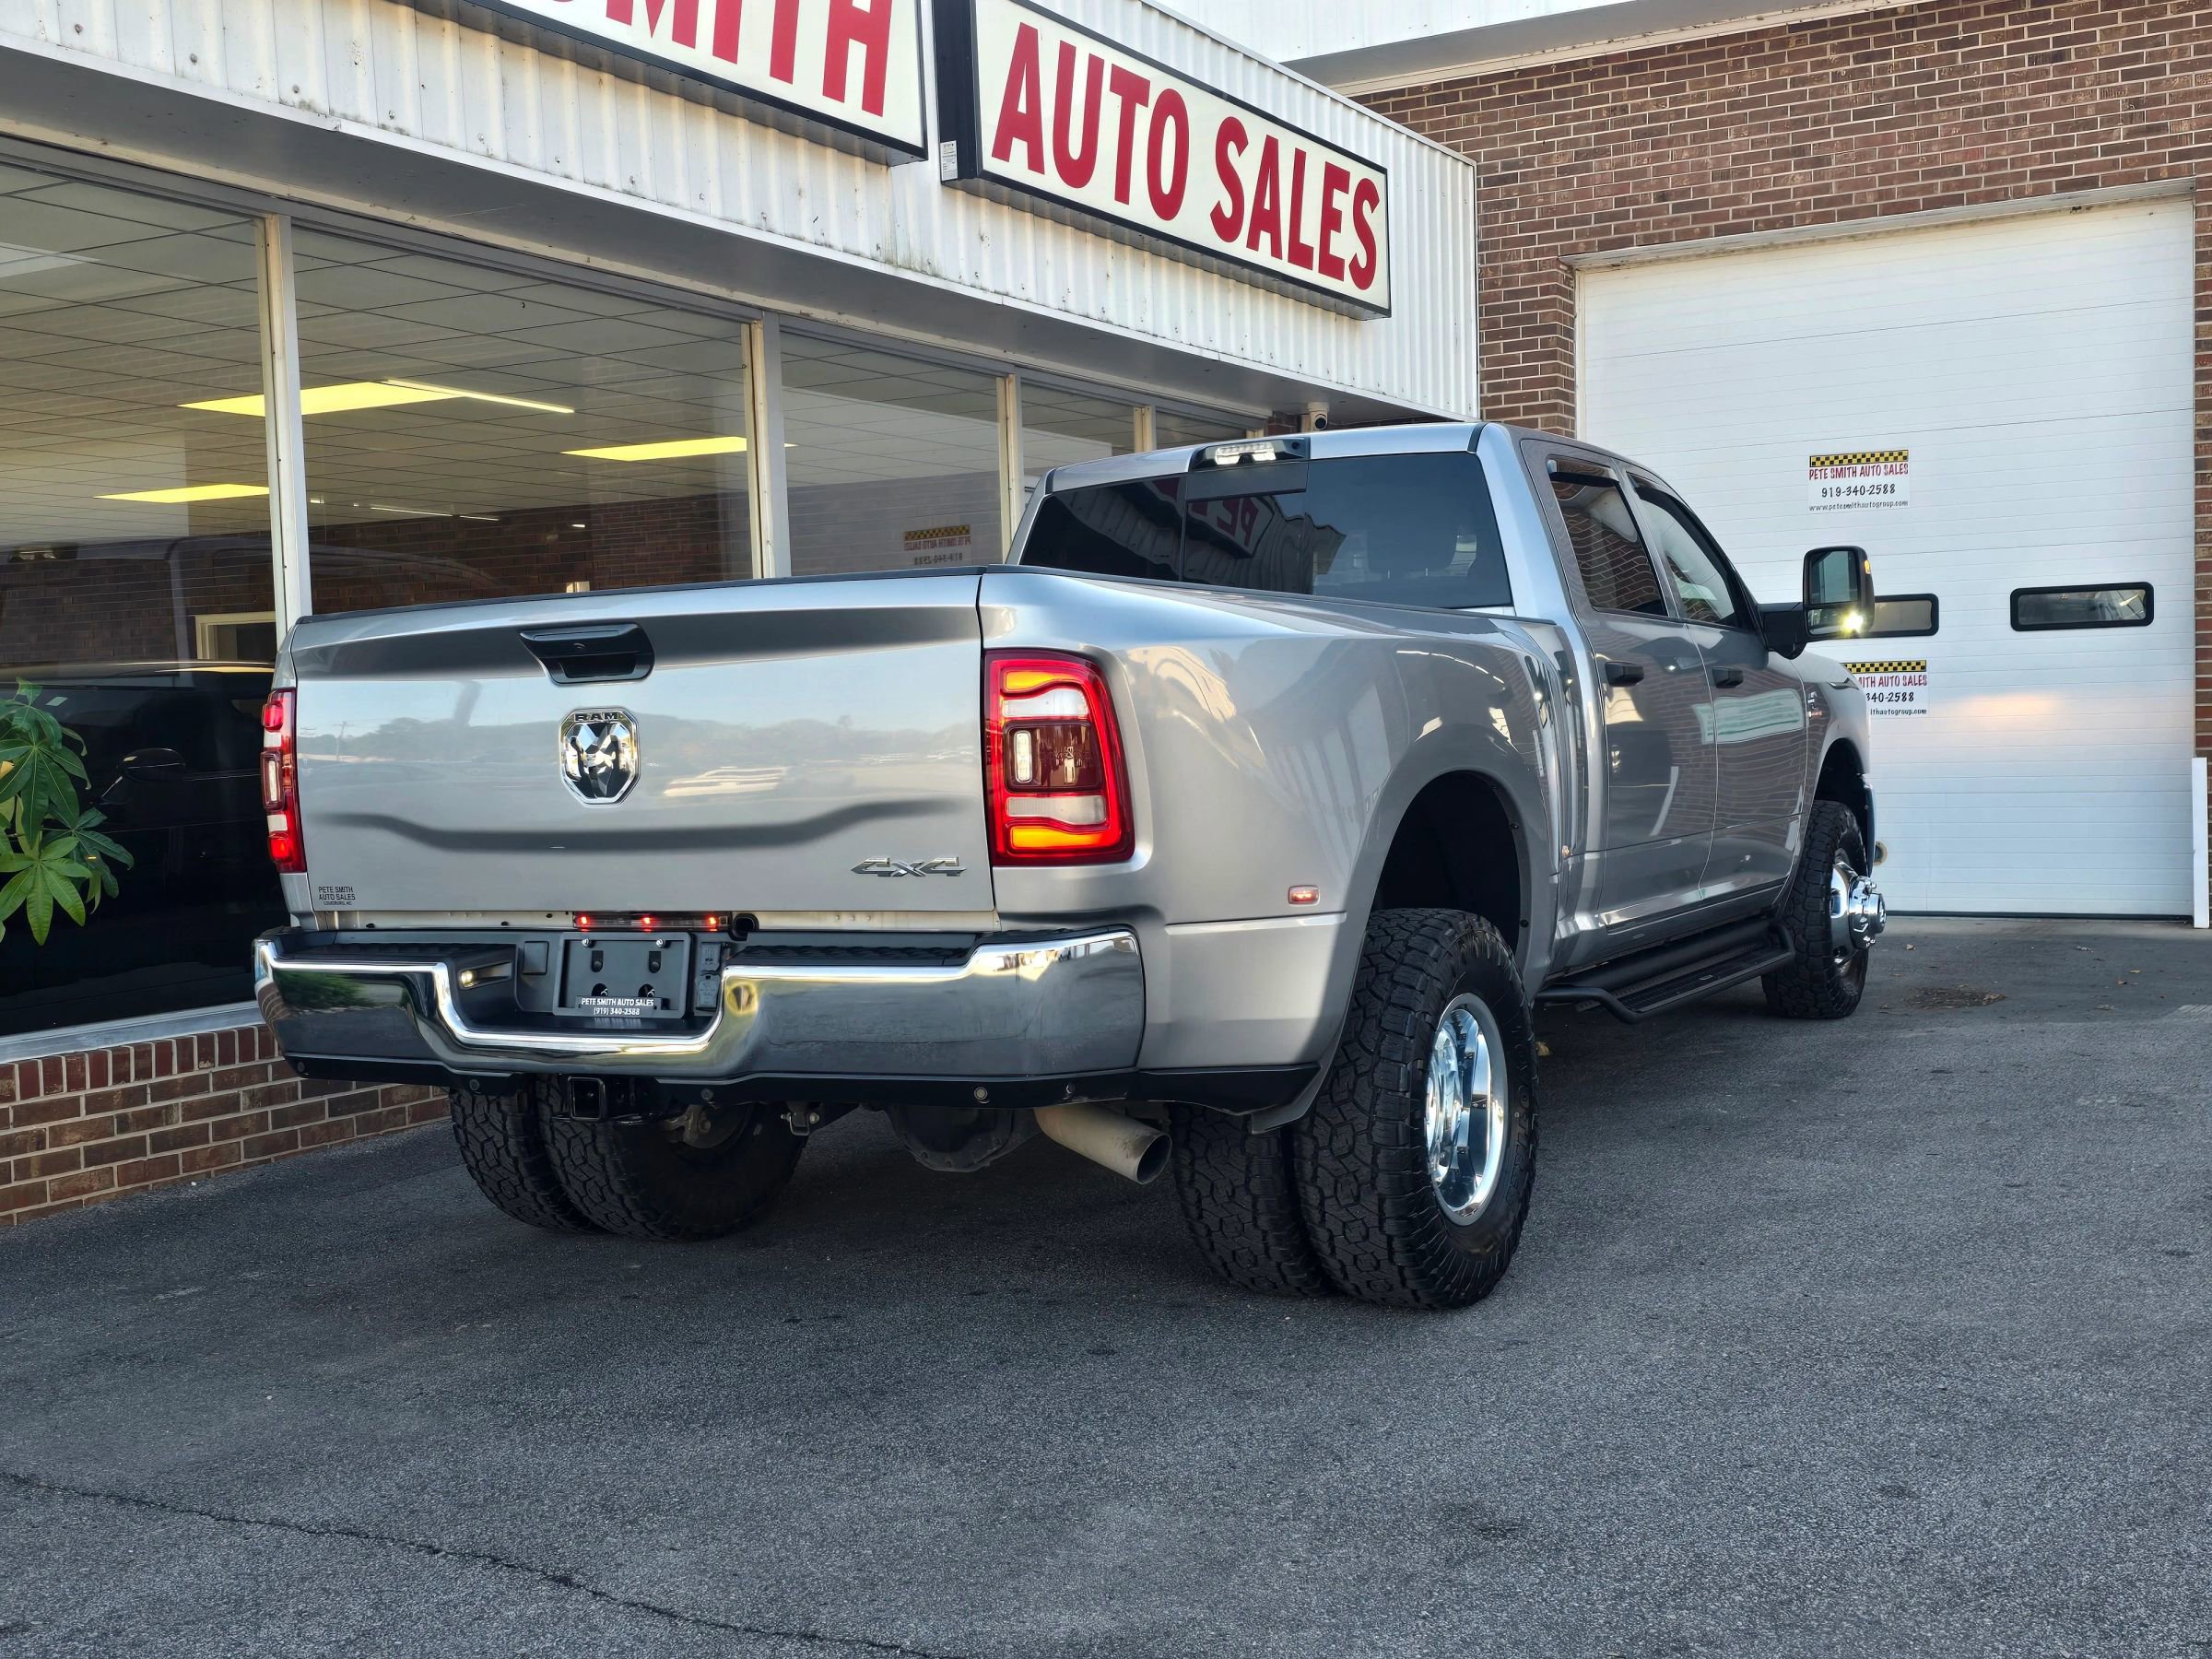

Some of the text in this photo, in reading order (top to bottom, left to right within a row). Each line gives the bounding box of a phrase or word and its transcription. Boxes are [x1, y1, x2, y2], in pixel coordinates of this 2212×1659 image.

[992, 22, 1190, 221] AUTO
[1210, 116, 1380, 290] SALES
[1809, 463, 1909, 480] PETE SMITH AUTO SALES
[1821, 483, 1896, 498] 919-340-2588
[1809, 500, 1909, 512] www.petesmithautogroup.com
[1858, 674, 1927, 688] ITH AUTO SALES
[1865, 692, 1914, 702] 340-2588
[574, 712, 618, 722] RAM
[1870, 708, 1927, 716] ithautogroup.com
[582, 997, 654, 1006] PETE SMITH AUTO SALES
[594, 1006, 609, 1016] (919)
